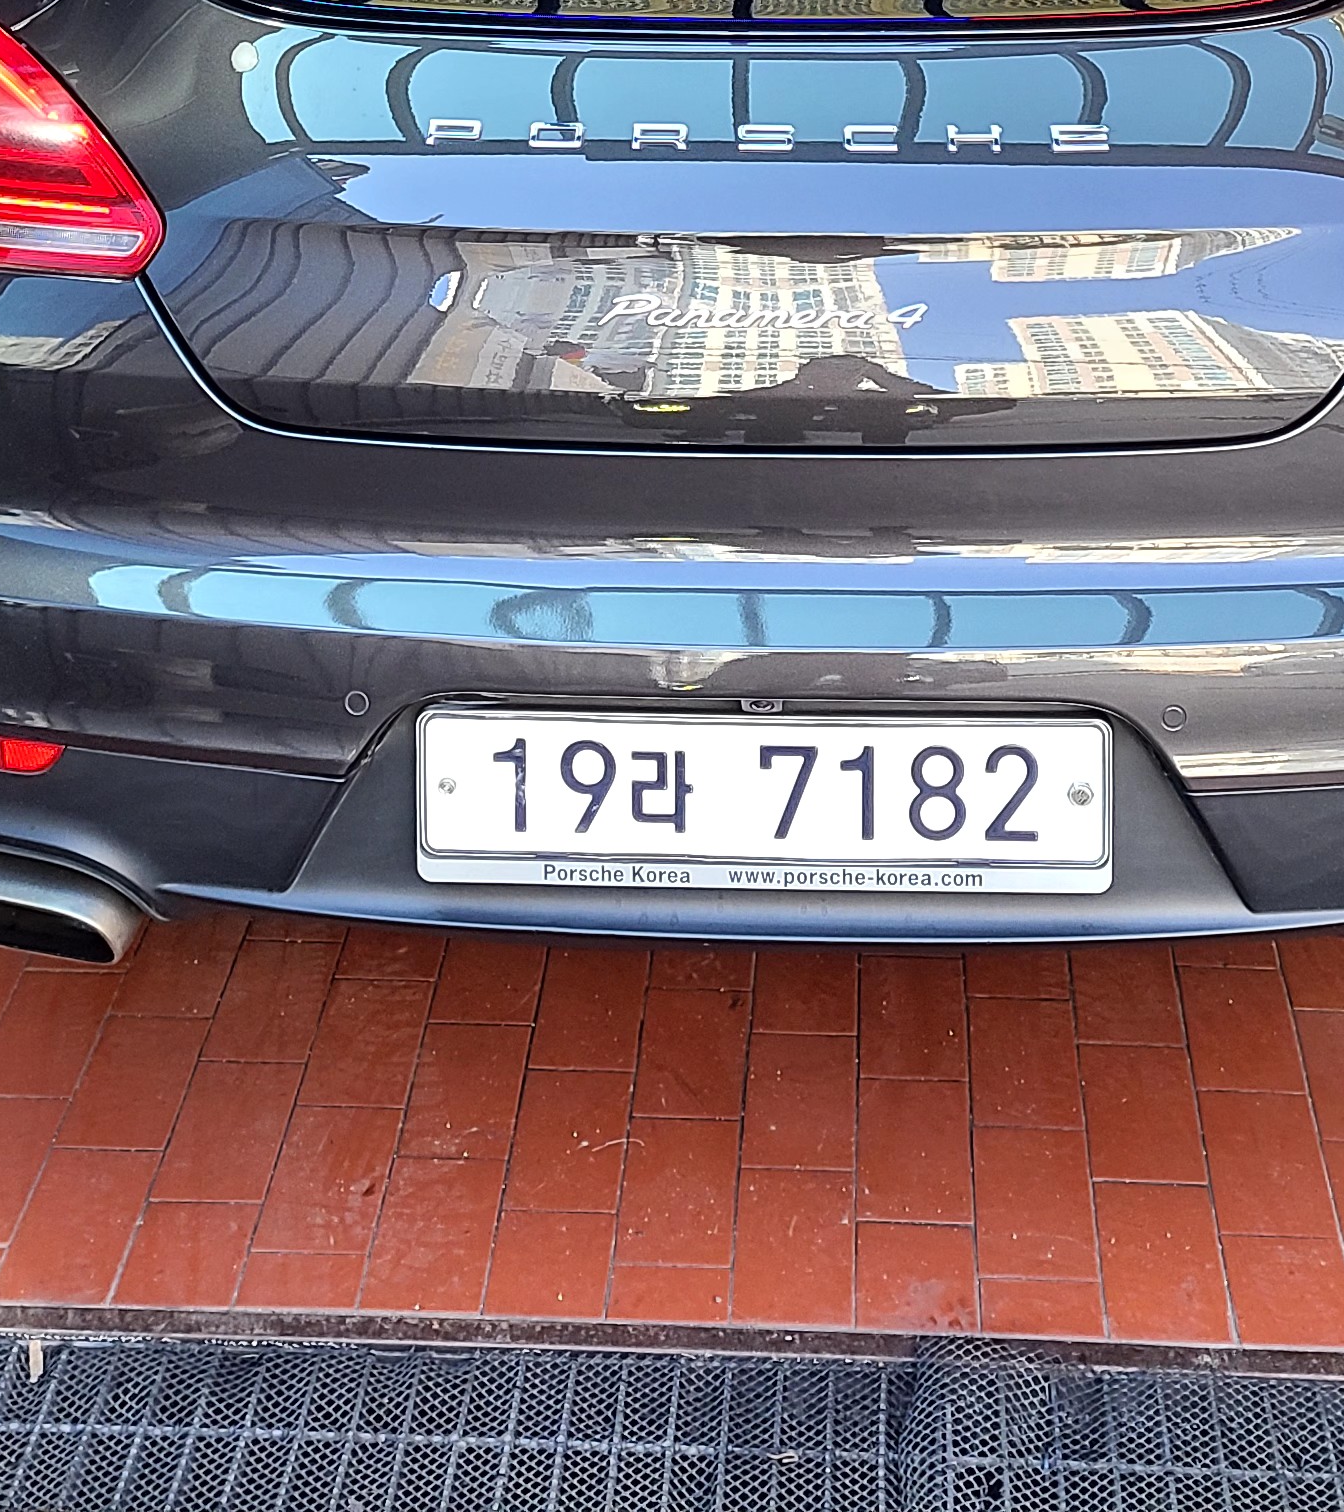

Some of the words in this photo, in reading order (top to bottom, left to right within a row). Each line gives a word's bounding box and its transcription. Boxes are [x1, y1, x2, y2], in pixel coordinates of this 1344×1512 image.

[426, 119, 1111, 154] PORSCHE
[598, 295, 874, 331] Panamera
[887, 303, 928, 330] 4
[492, 737, 694, 834] 19라
[759, 744, 1040, 842] 7182
[543, 863, 624, 884] Porsche
[631, 865, 692, 885] Korea
[728, 866, 984, 889] www.porsche-korea.com
